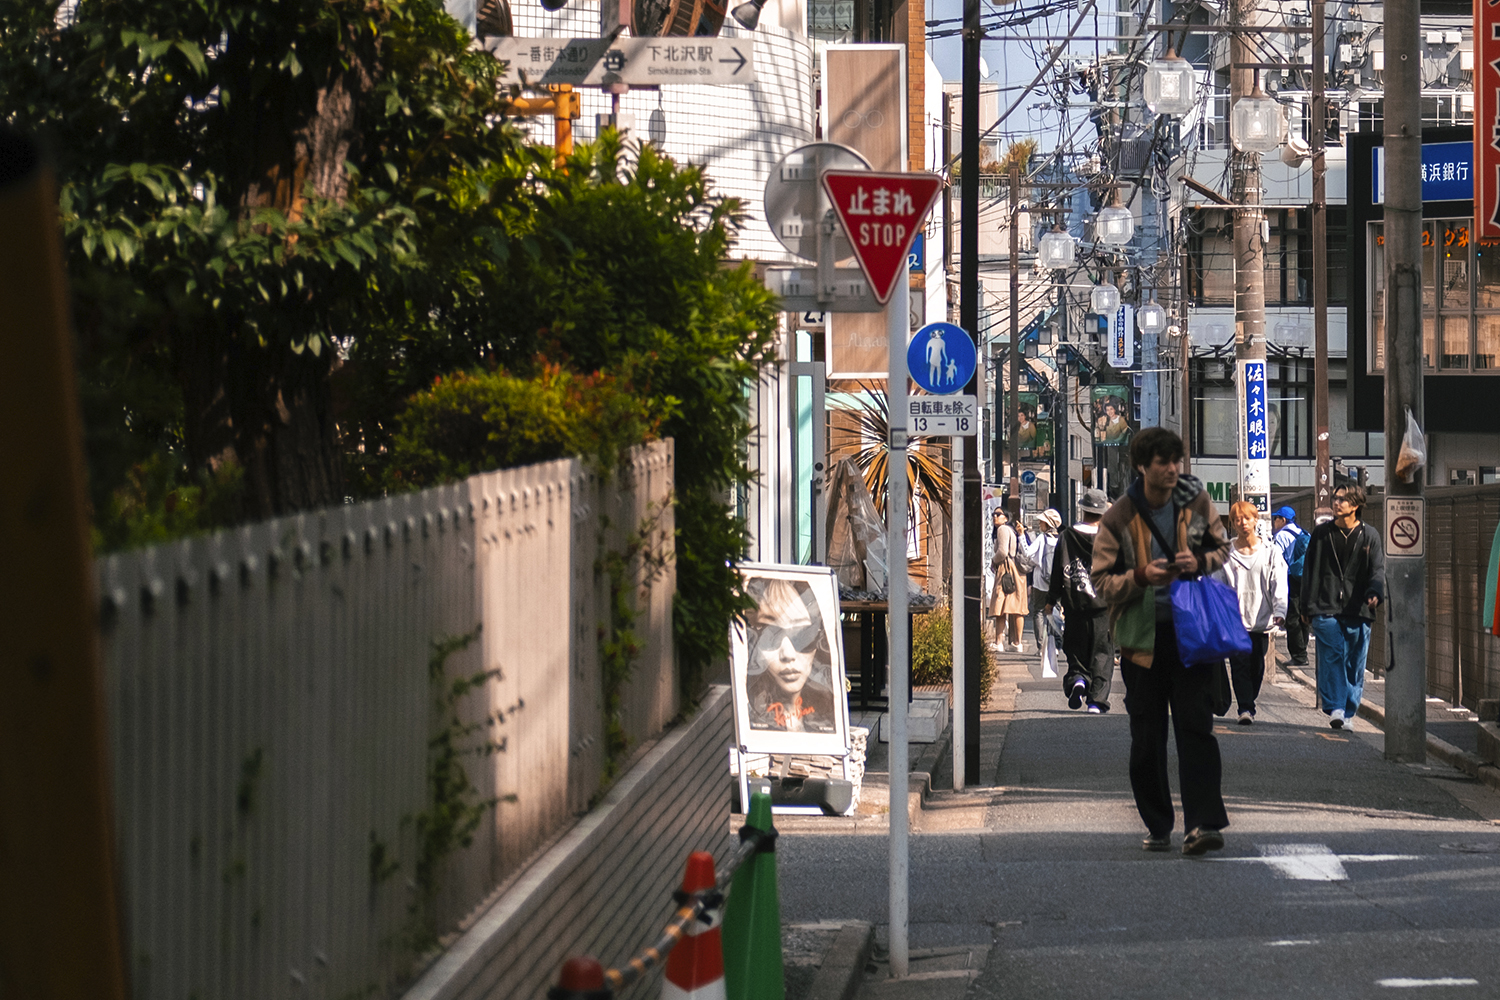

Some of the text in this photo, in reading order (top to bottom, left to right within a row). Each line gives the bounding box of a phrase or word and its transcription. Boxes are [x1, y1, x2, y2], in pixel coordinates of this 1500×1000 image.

[517, 46, 589, 63] 一番街本通り
[647, 46, 713, 63] 下北沢駅
[848, 186, 915, 216] 止まれ
[859, 223, 906, 247] STOP
[910, 401, 973, 414] 自転車を除く
[1247, 364, 1267, 458] 佐々木眼科
[913, 418, 928, 431] 13
[956, 418, 969, 431] 18
